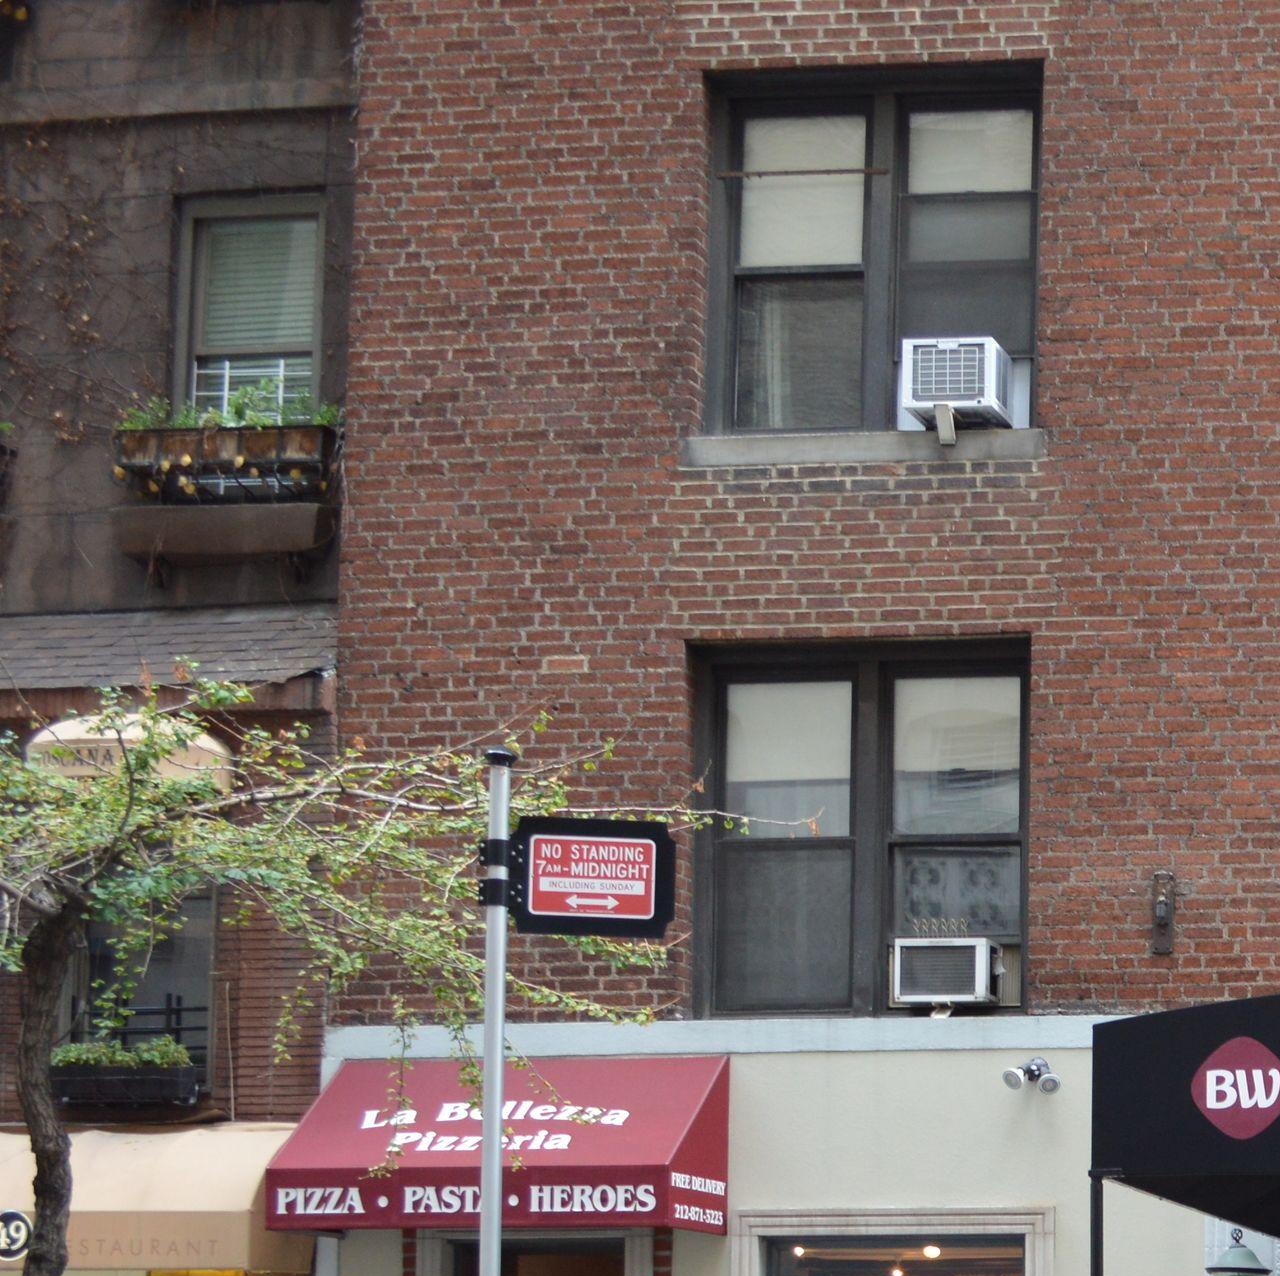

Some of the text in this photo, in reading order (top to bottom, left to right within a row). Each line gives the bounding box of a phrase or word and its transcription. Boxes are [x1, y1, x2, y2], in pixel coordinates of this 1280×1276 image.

[541, 843, 644, 862] NO STANDING
[549, 880, 635, 892] INCLUDING SUNDAY
[1205, 1067, 1280, 1110] BW
[360, 1107, 418, 1129] La
[671, 1171, 727, 1196] FREE DELIVERY
[275, 1187, 366, 1215] PIZZA
[529, 1185, 657, 1213] HEROES
[65, 1239, 219, 1257] STAURANT
